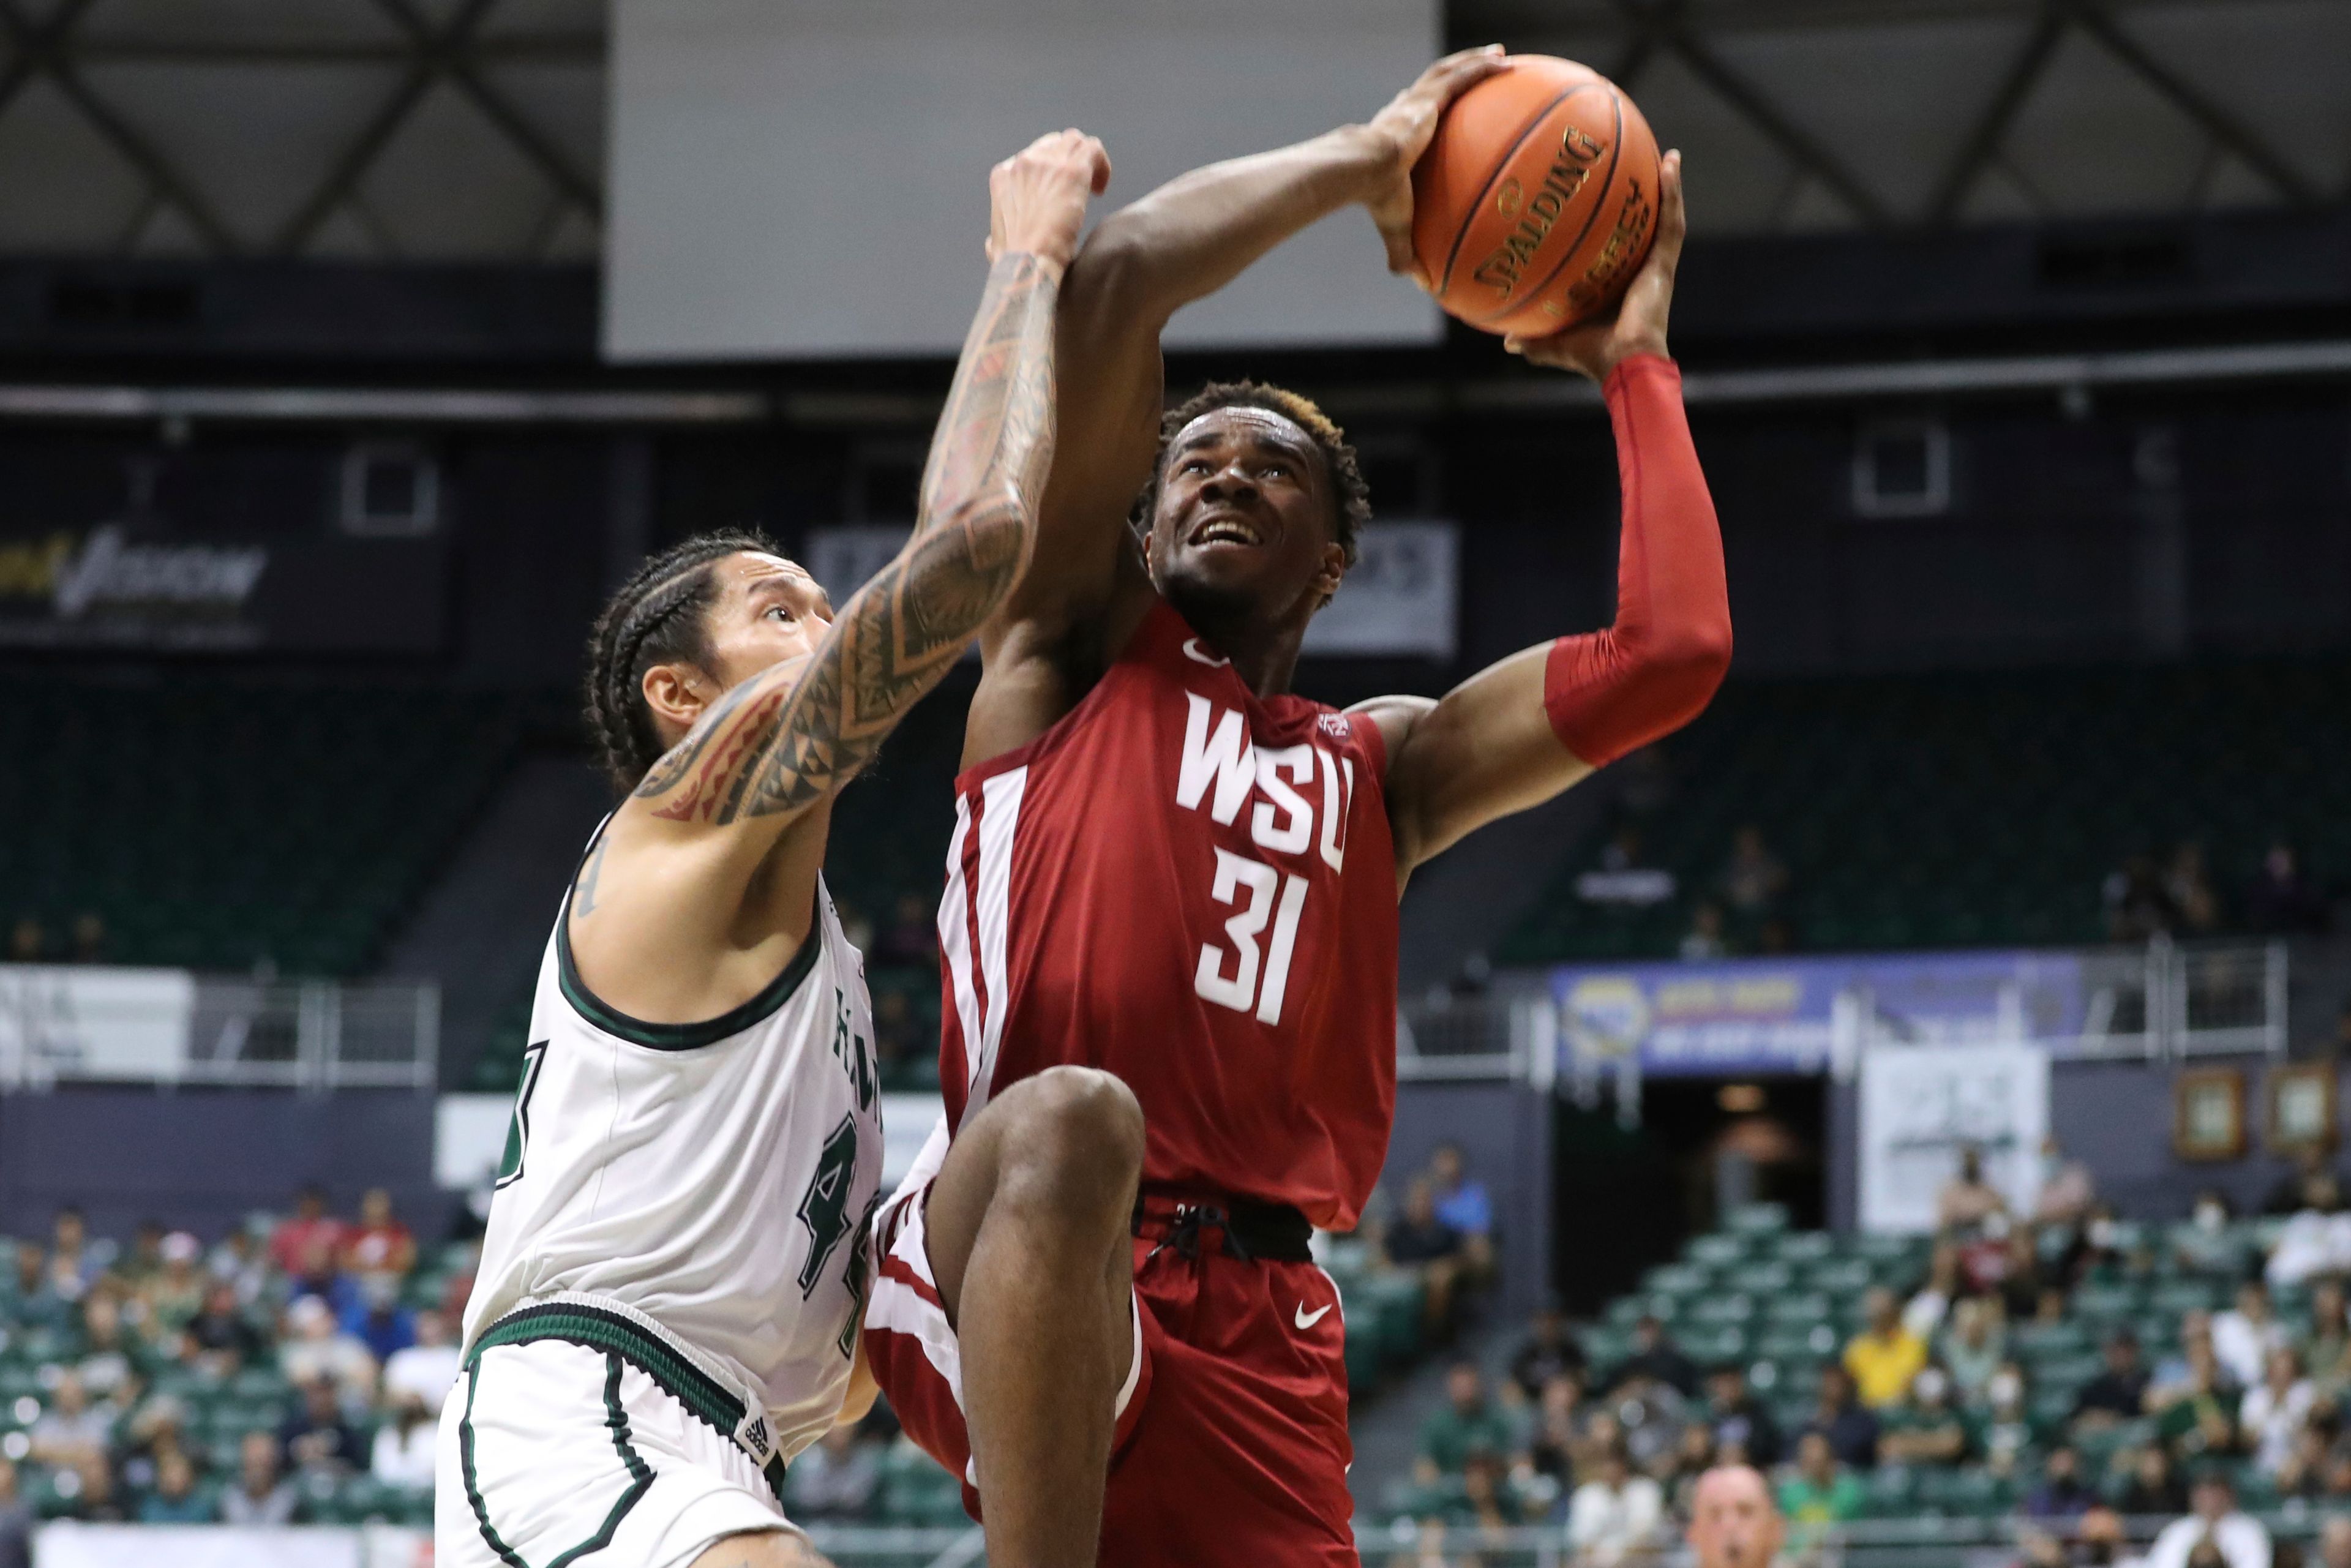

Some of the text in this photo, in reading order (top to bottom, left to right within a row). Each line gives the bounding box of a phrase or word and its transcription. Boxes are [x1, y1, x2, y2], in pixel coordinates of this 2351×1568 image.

[1474, 125, 1605, 301] SPALDING
[1176, 689, 1353, 875] WSU
[1194, 845, 1308, 1026] 31
[746, 1428, 769, 1457] adidas
